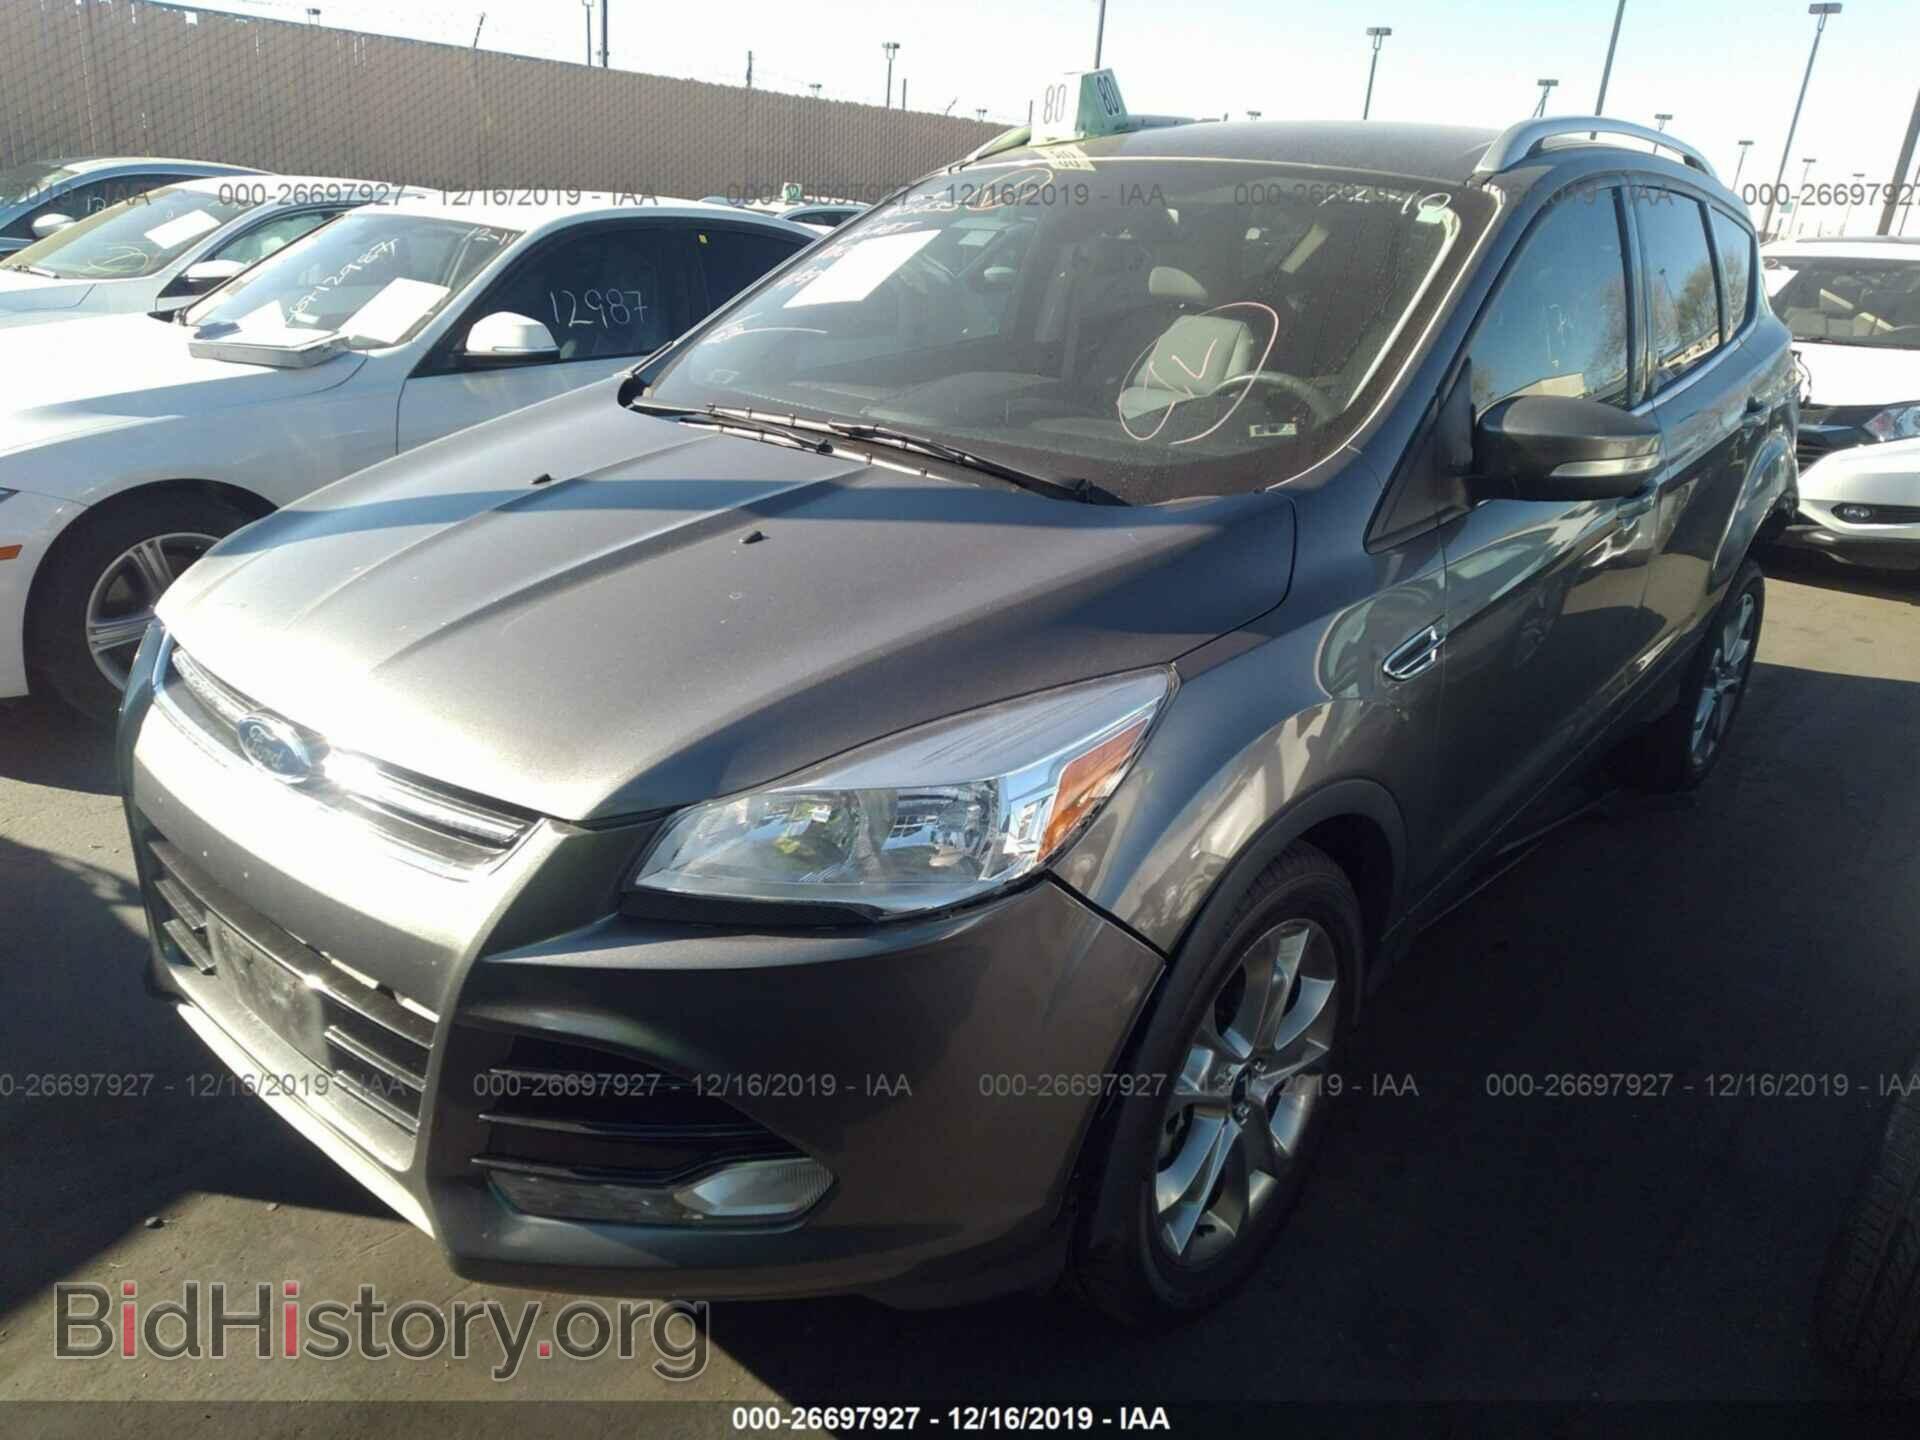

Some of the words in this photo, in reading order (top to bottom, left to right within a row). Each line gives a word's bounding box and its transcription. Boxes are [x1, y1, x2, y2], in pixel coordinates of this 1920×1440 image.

[1043, 83, 1067, 125] 80
[1097, 76, 1121, 116] 80
[549, 288, 648, 328] 12987
